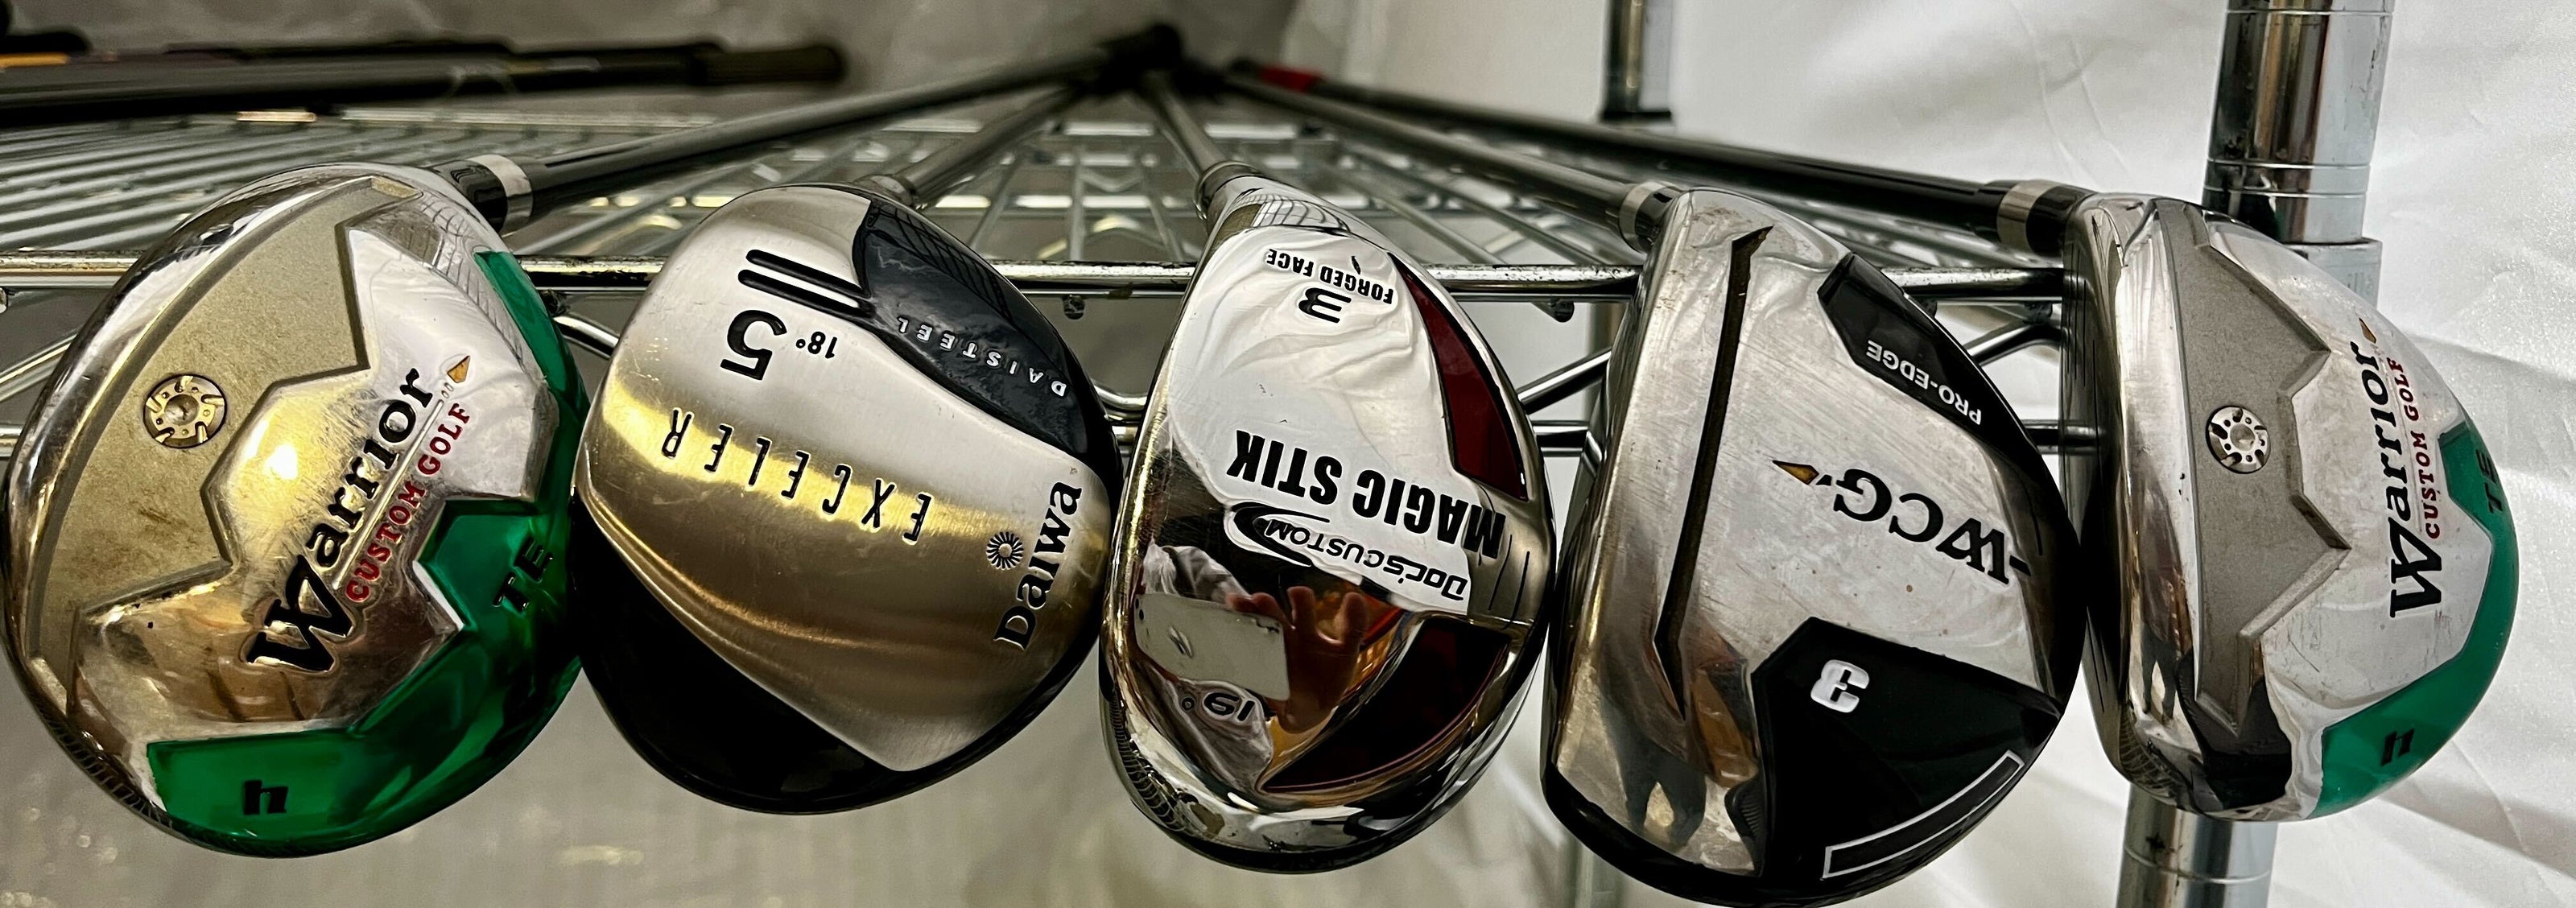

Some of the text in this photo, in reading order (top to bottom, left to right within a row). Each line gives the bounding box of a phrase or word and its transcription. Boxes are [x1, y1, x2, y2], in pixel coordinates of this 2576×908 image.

[1265, 248, 1394, 305] FORGED FACE
[1298, 287, 1352, 324] 3
[720, 309, 787, 381] 5
[897, 316, 1067, 398] DAISTEEL
[1865, 340, 1982, 426] PRO-EDGE
[661, 408, 932, 544] EXCELER
[1225, 429, 1507, 560] MAGIC STIK
[2349, 340, 2443, 618] Warrior
[2386, 356, 2441, 540] CUSTOM GOLF
[246, 367, 434, 674] Warrior
[345, 402, 472, 604] CUSTOM GOLF
[492, 536, 554, 613] TE
[993, 481, 1082, 650] Daiwa
[1809, 658, 1870, 714] 3
